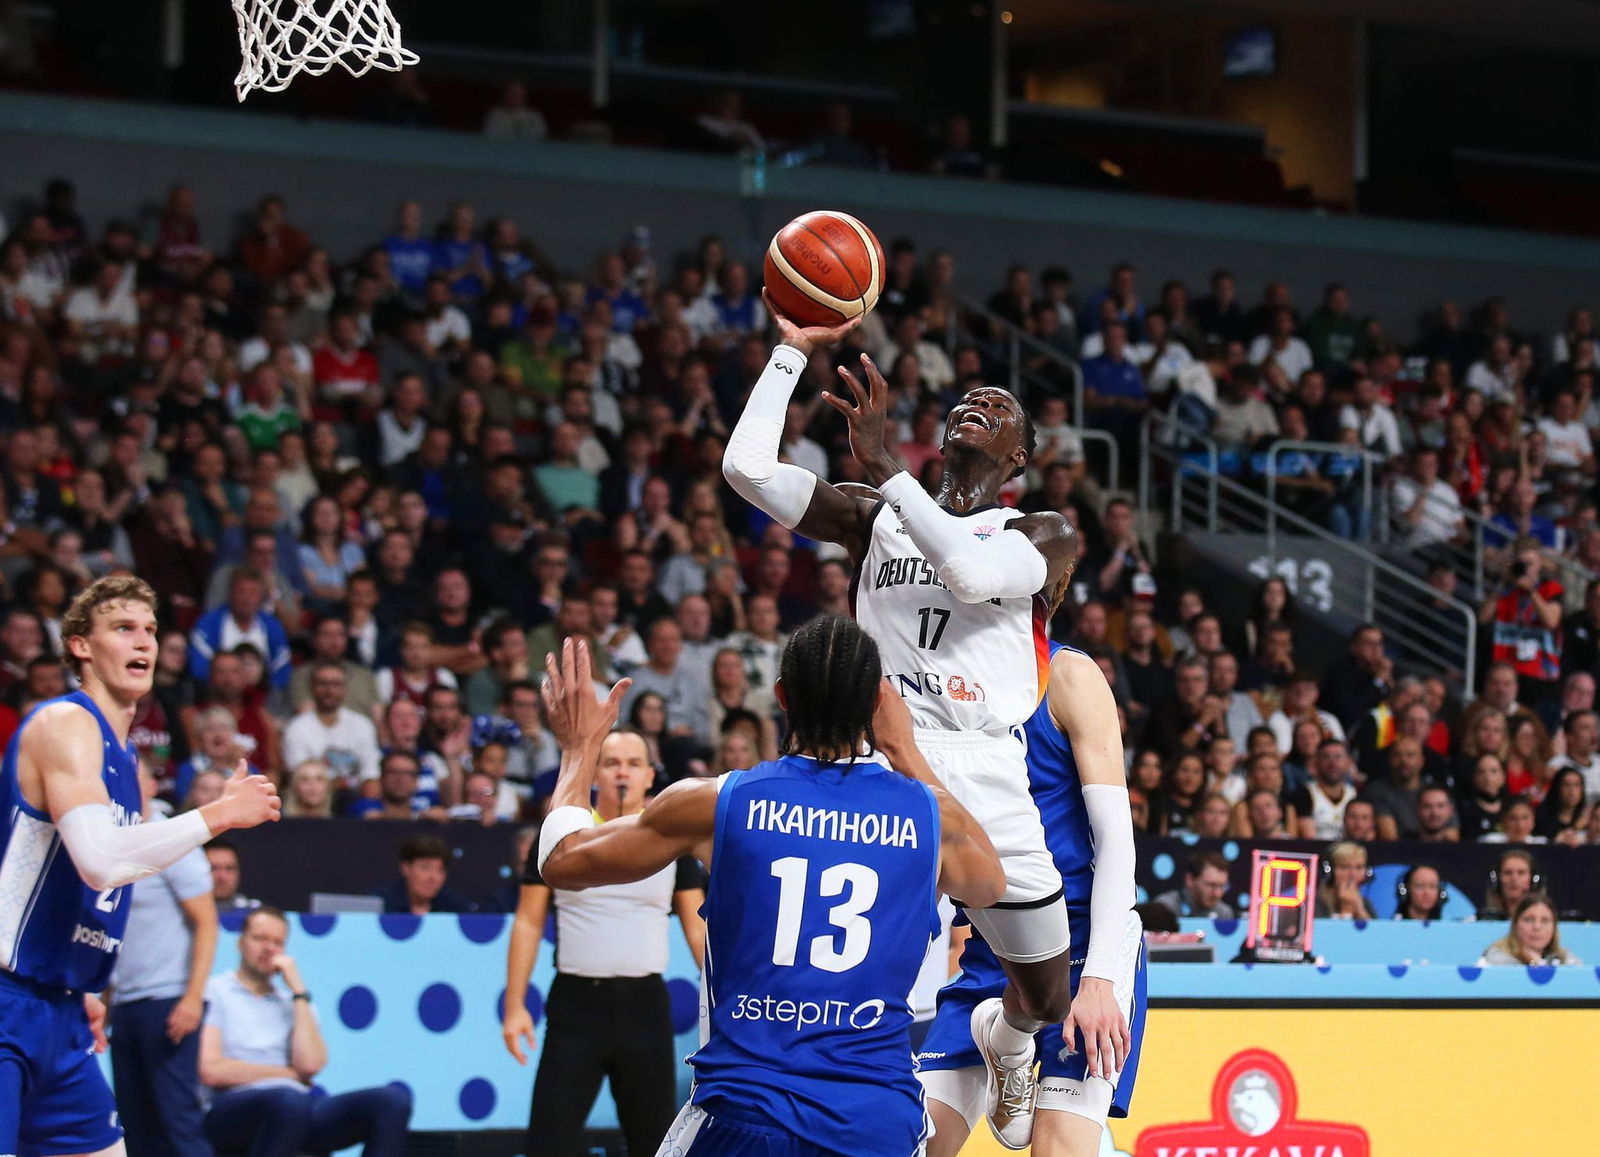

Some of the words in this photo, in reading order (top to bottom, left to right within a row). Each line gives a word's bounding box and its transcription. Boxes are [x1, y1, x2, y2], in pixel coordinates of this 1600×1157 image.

[791, 235, 832, 275] molten
[917, 607, 951, 651] 17
[770, 856, 879, 973] 13
[1259, 859, 1308, 937] P
[1042, 1086, 1071, 1094] CRAFT
